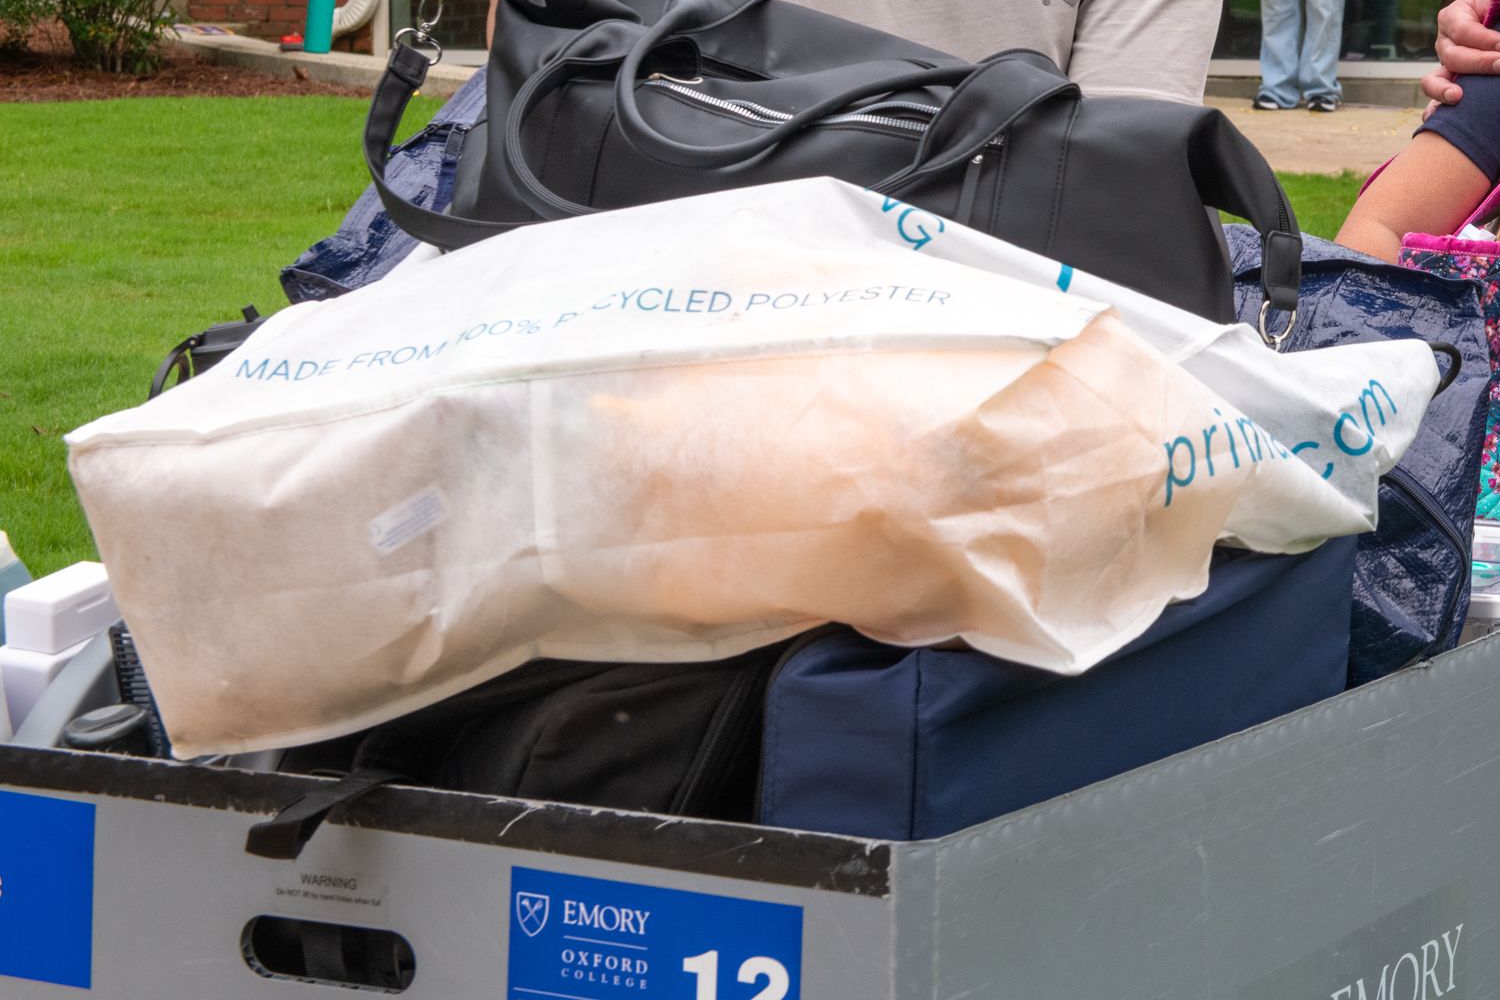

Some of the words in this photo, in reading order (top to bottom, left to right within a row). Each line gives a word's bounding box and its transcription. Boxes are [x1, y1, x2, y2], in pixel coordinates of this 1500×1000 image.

[235, 358, 344, 382] MADE
[347, 340, 449, 370] FROM
[455, 319, 541, 345] 100%
[745, 285, 952, 313] POLYESTER
[300, 873, 358, 890] WARNING
[562, 900, 650, 935] EMORY
[561, 949, 648, 974] OXFORD
[561, 967, 647, 990] COLLEGE
